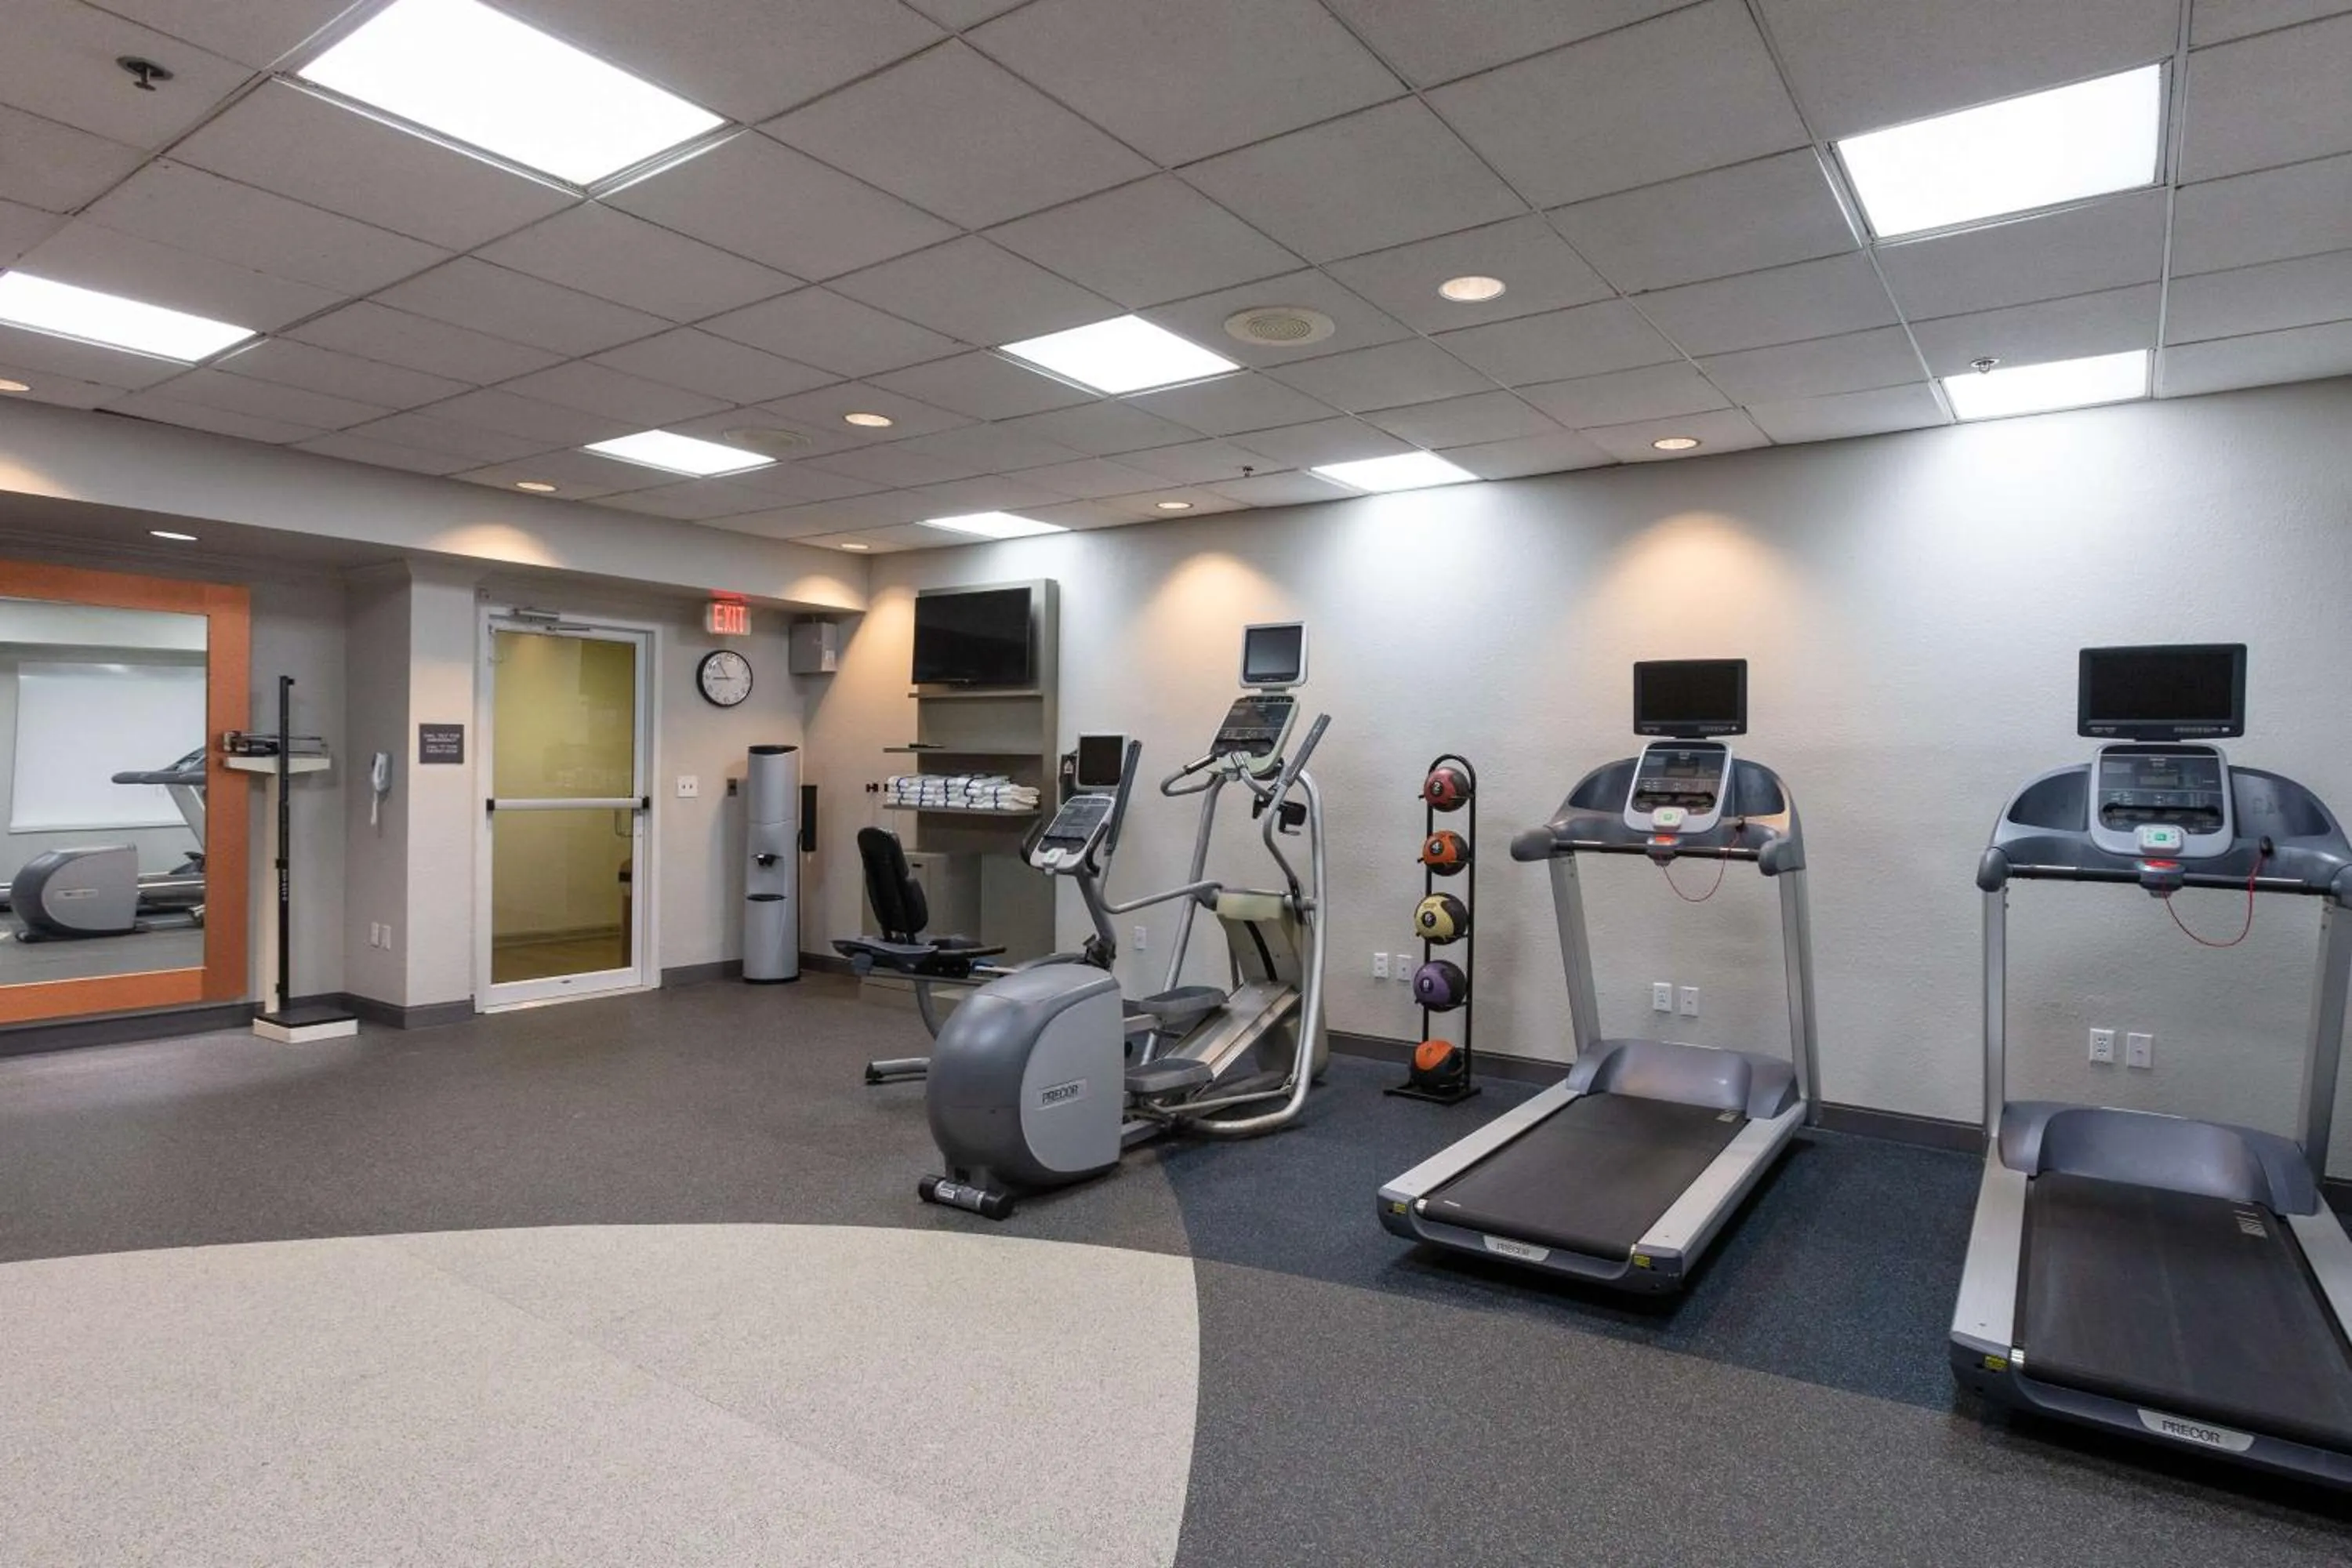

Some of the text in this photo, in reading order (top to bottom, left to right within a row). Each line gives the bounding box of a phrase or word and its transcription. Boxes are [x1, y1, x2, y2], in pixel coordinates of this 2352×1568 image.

[714, 604, 746, 633] EXIT
[1042, 1084, 1079, 1104] PRECOR
[2161, 1420, 2221, 1443] PRECOR
